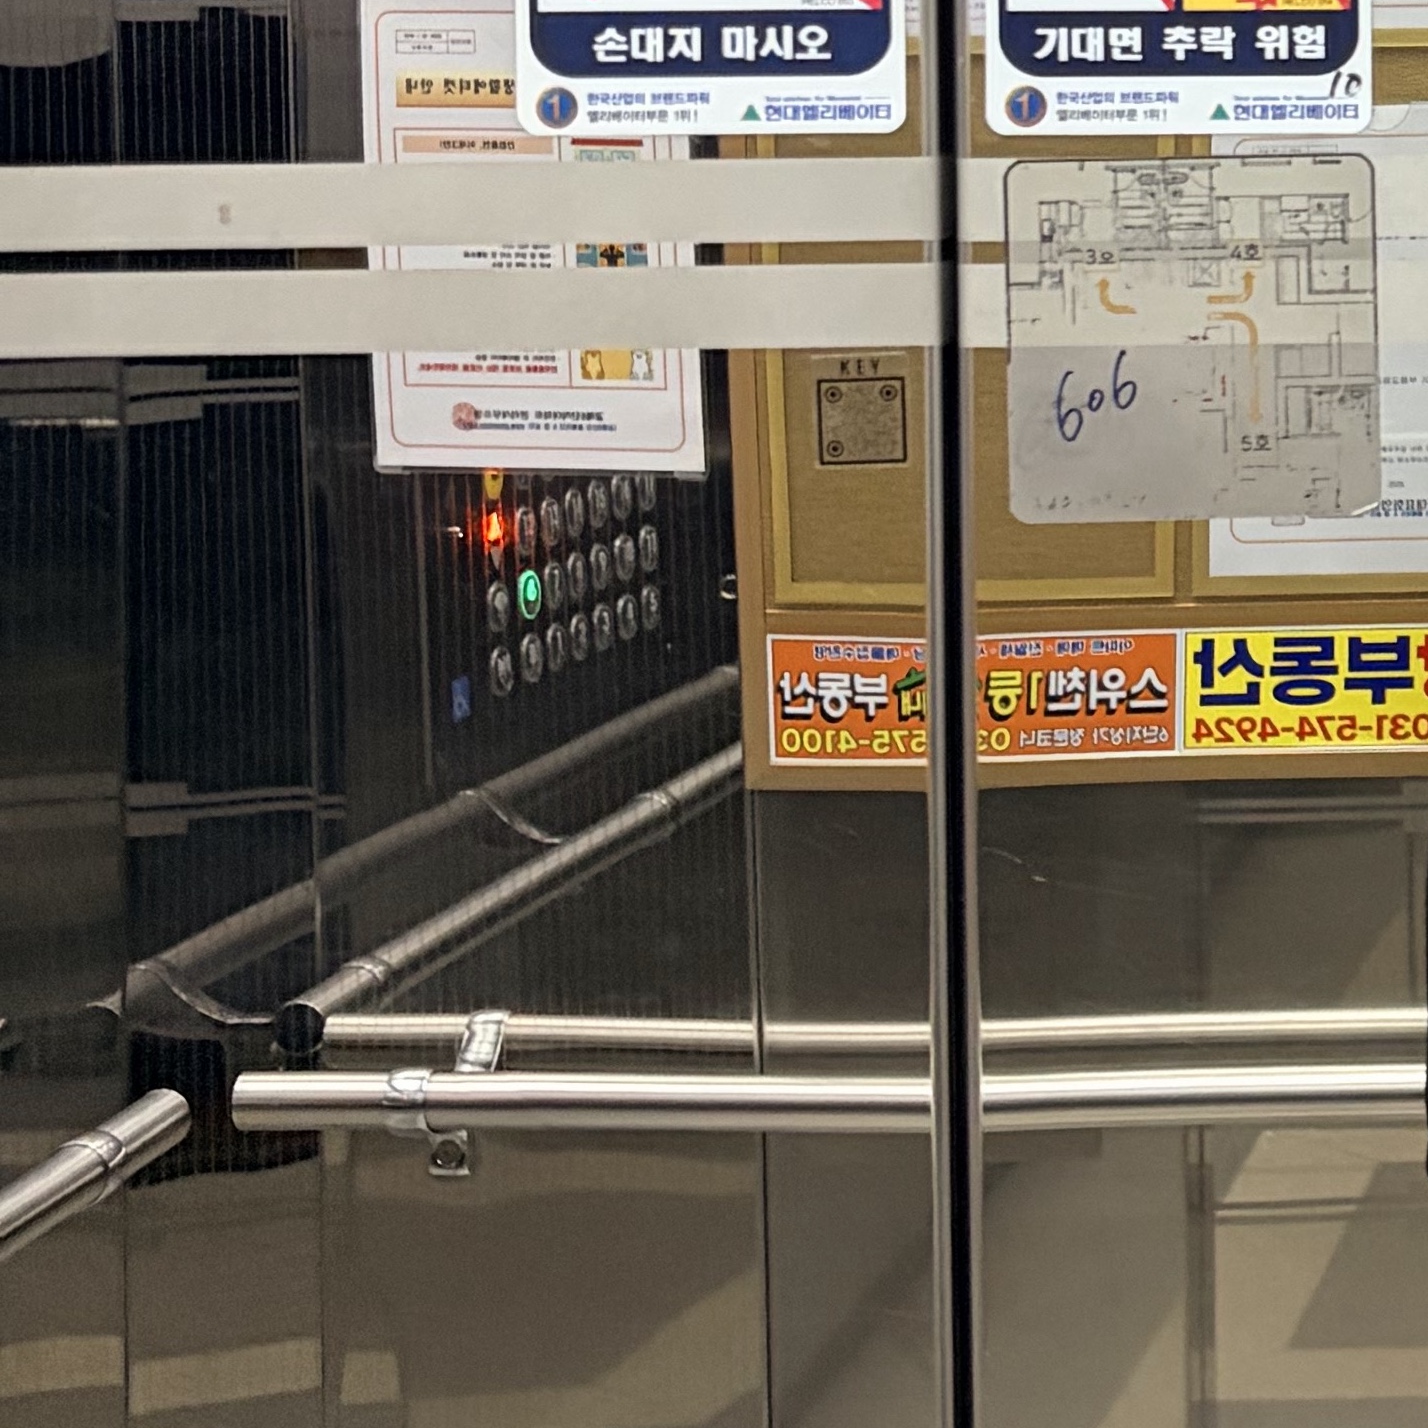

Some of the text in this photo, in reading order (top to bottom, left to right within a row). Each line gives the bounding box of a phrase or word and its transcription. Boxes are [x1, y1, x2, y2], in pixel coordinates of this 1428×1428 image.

[593, 26, 833, 62] 손대지 마시오
[1034, 25, 1327, 62] 기대면 추락 위험
[765, 104, 892, 122] 현대엘리베이터
[1233, 103, 1359, 121] 현대엘리베이터
[1084, 248, 1114, 265] 3호
[1053, 350, 1138, 442] 606
[1241, 435, 1272, 452] 5호
